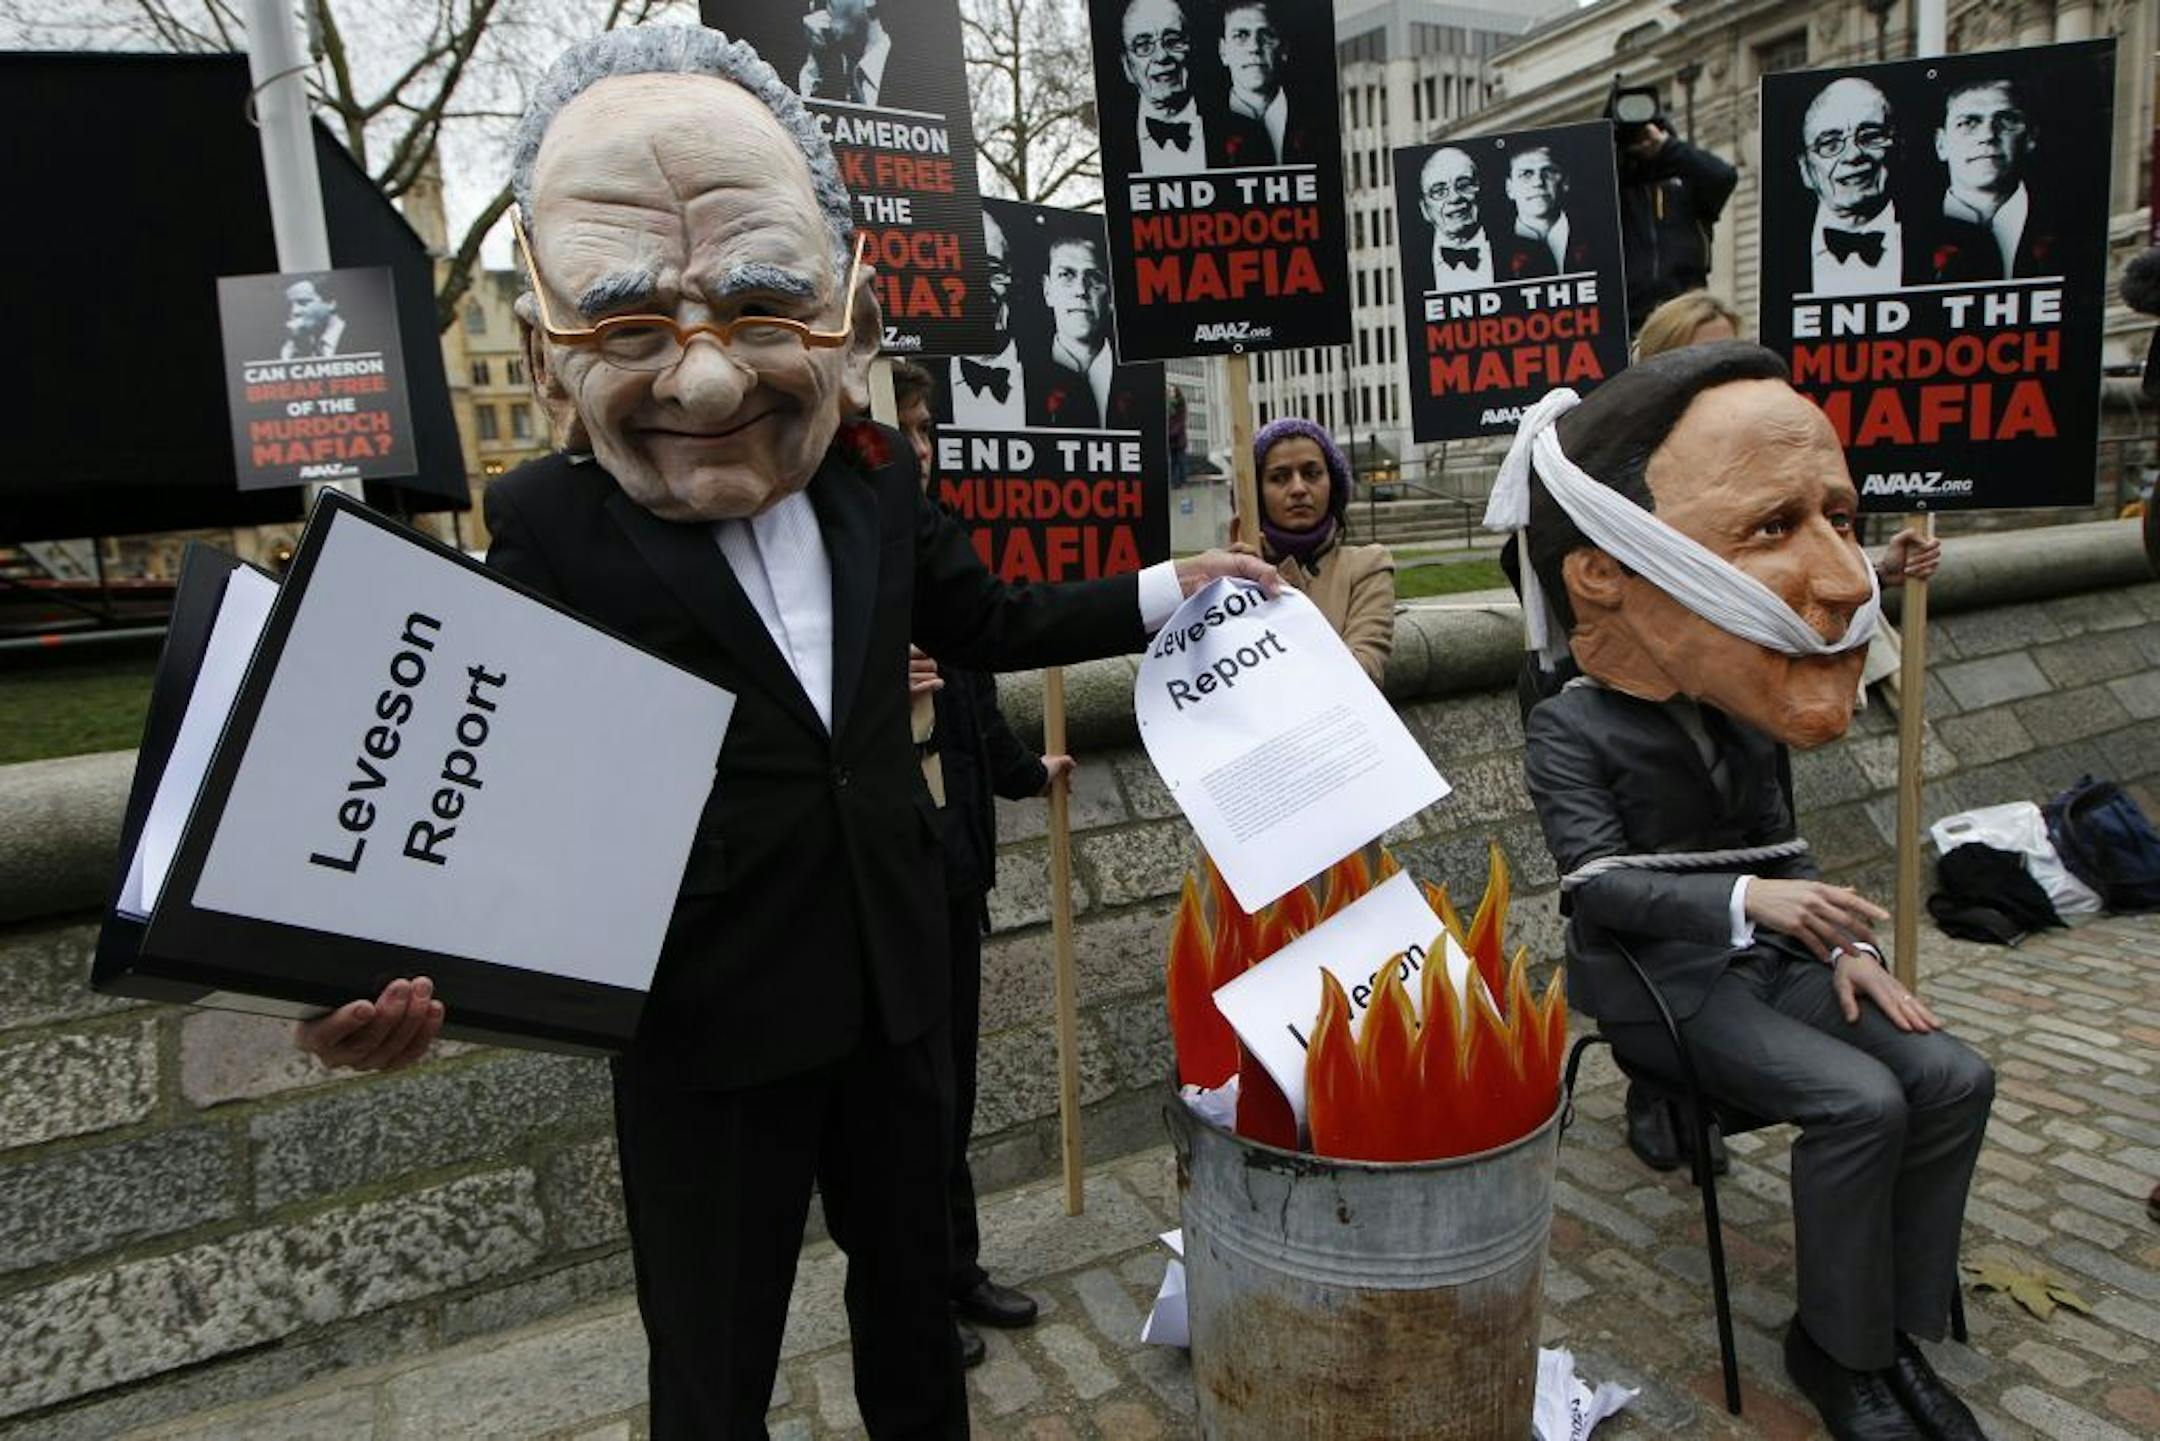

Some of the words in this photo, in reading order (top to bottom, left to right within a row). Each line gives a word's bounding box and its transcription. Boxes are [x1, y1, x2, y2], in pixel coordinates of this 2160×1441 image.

[815, 114, 949, 153] CAMERON
[875, 154, 955, 193] FREE
[1129, 180, 1216, 212] END
[1236, 175, 1317, 204] THE
[858, 195, 912, 224] THE
[1132, 207, 1319, 251] MURDOCH
[854, 227, 963, 271] DOCH
[1135, 247, 1324, 306] MAFIA
[1425, 293, 1501, 321] END
[1520, 280, 1598, 310] THE
[1793, 301, 1910, 338] END
[1942, 289, 2062, 328] THE
[1426, 306, 1600, 353] MURDOCH
[244, 367, 286, 383] CAN
[290, 359, 384, 379] CAMERON
[1429, 341, 1604, 396] MAFIA
[1792, 330, 2060, 385] MURDOCH
[246, 381, 322, 402] BREAK
[330, 376, 388, 394] FREE
[286, 402, 314, 416] OF
[318, 398, 356, 414] THE
[250, 411, 390, 442] MURDOCH
[252, 434, 393, 467] MAFIA?
[937, 437, 1035, 471] END
[1056, 440, 1142, 472] THE
[939, 478, 1143, 520] MURDOCH
[1862, 472, 1973, 496] AVAAZ.ORG
[1166, 629, 1287, 711] Report
[309, 612, 442, 873] Leveson
[403, 664, 507, 865] Report
